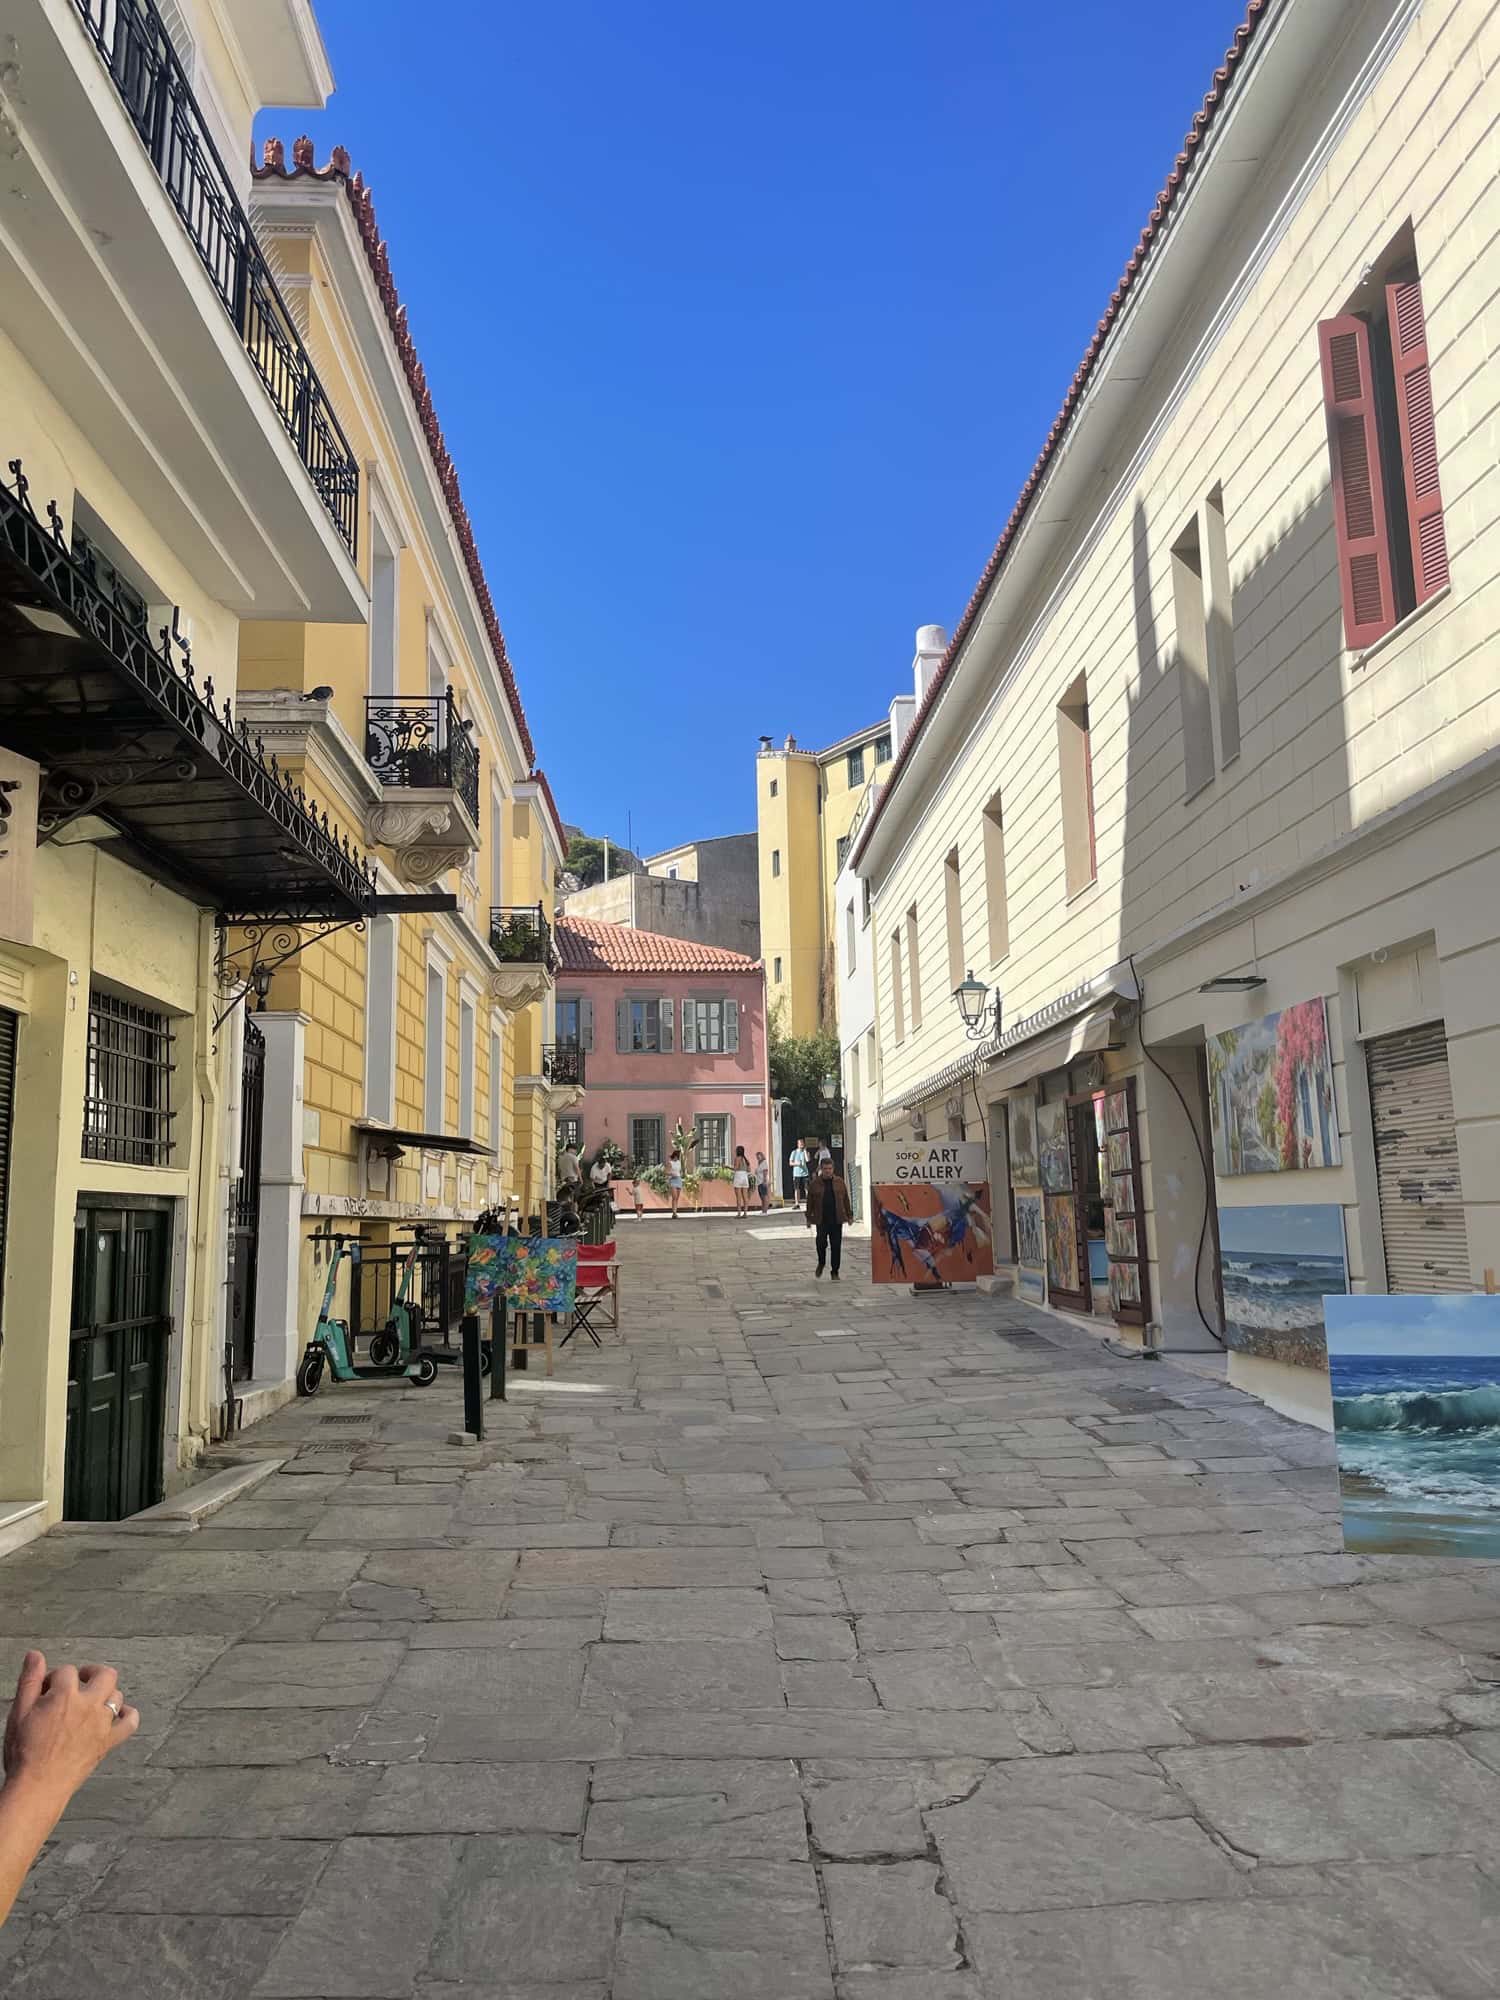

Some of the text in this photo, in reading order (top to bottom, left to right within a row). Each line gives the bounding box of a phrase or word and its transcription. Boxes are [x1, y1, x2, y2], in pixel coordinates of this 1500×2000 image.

[895, 1148, 959, 1162] SOFO ART
[895, 1166, 963, 1179] GALLERY
